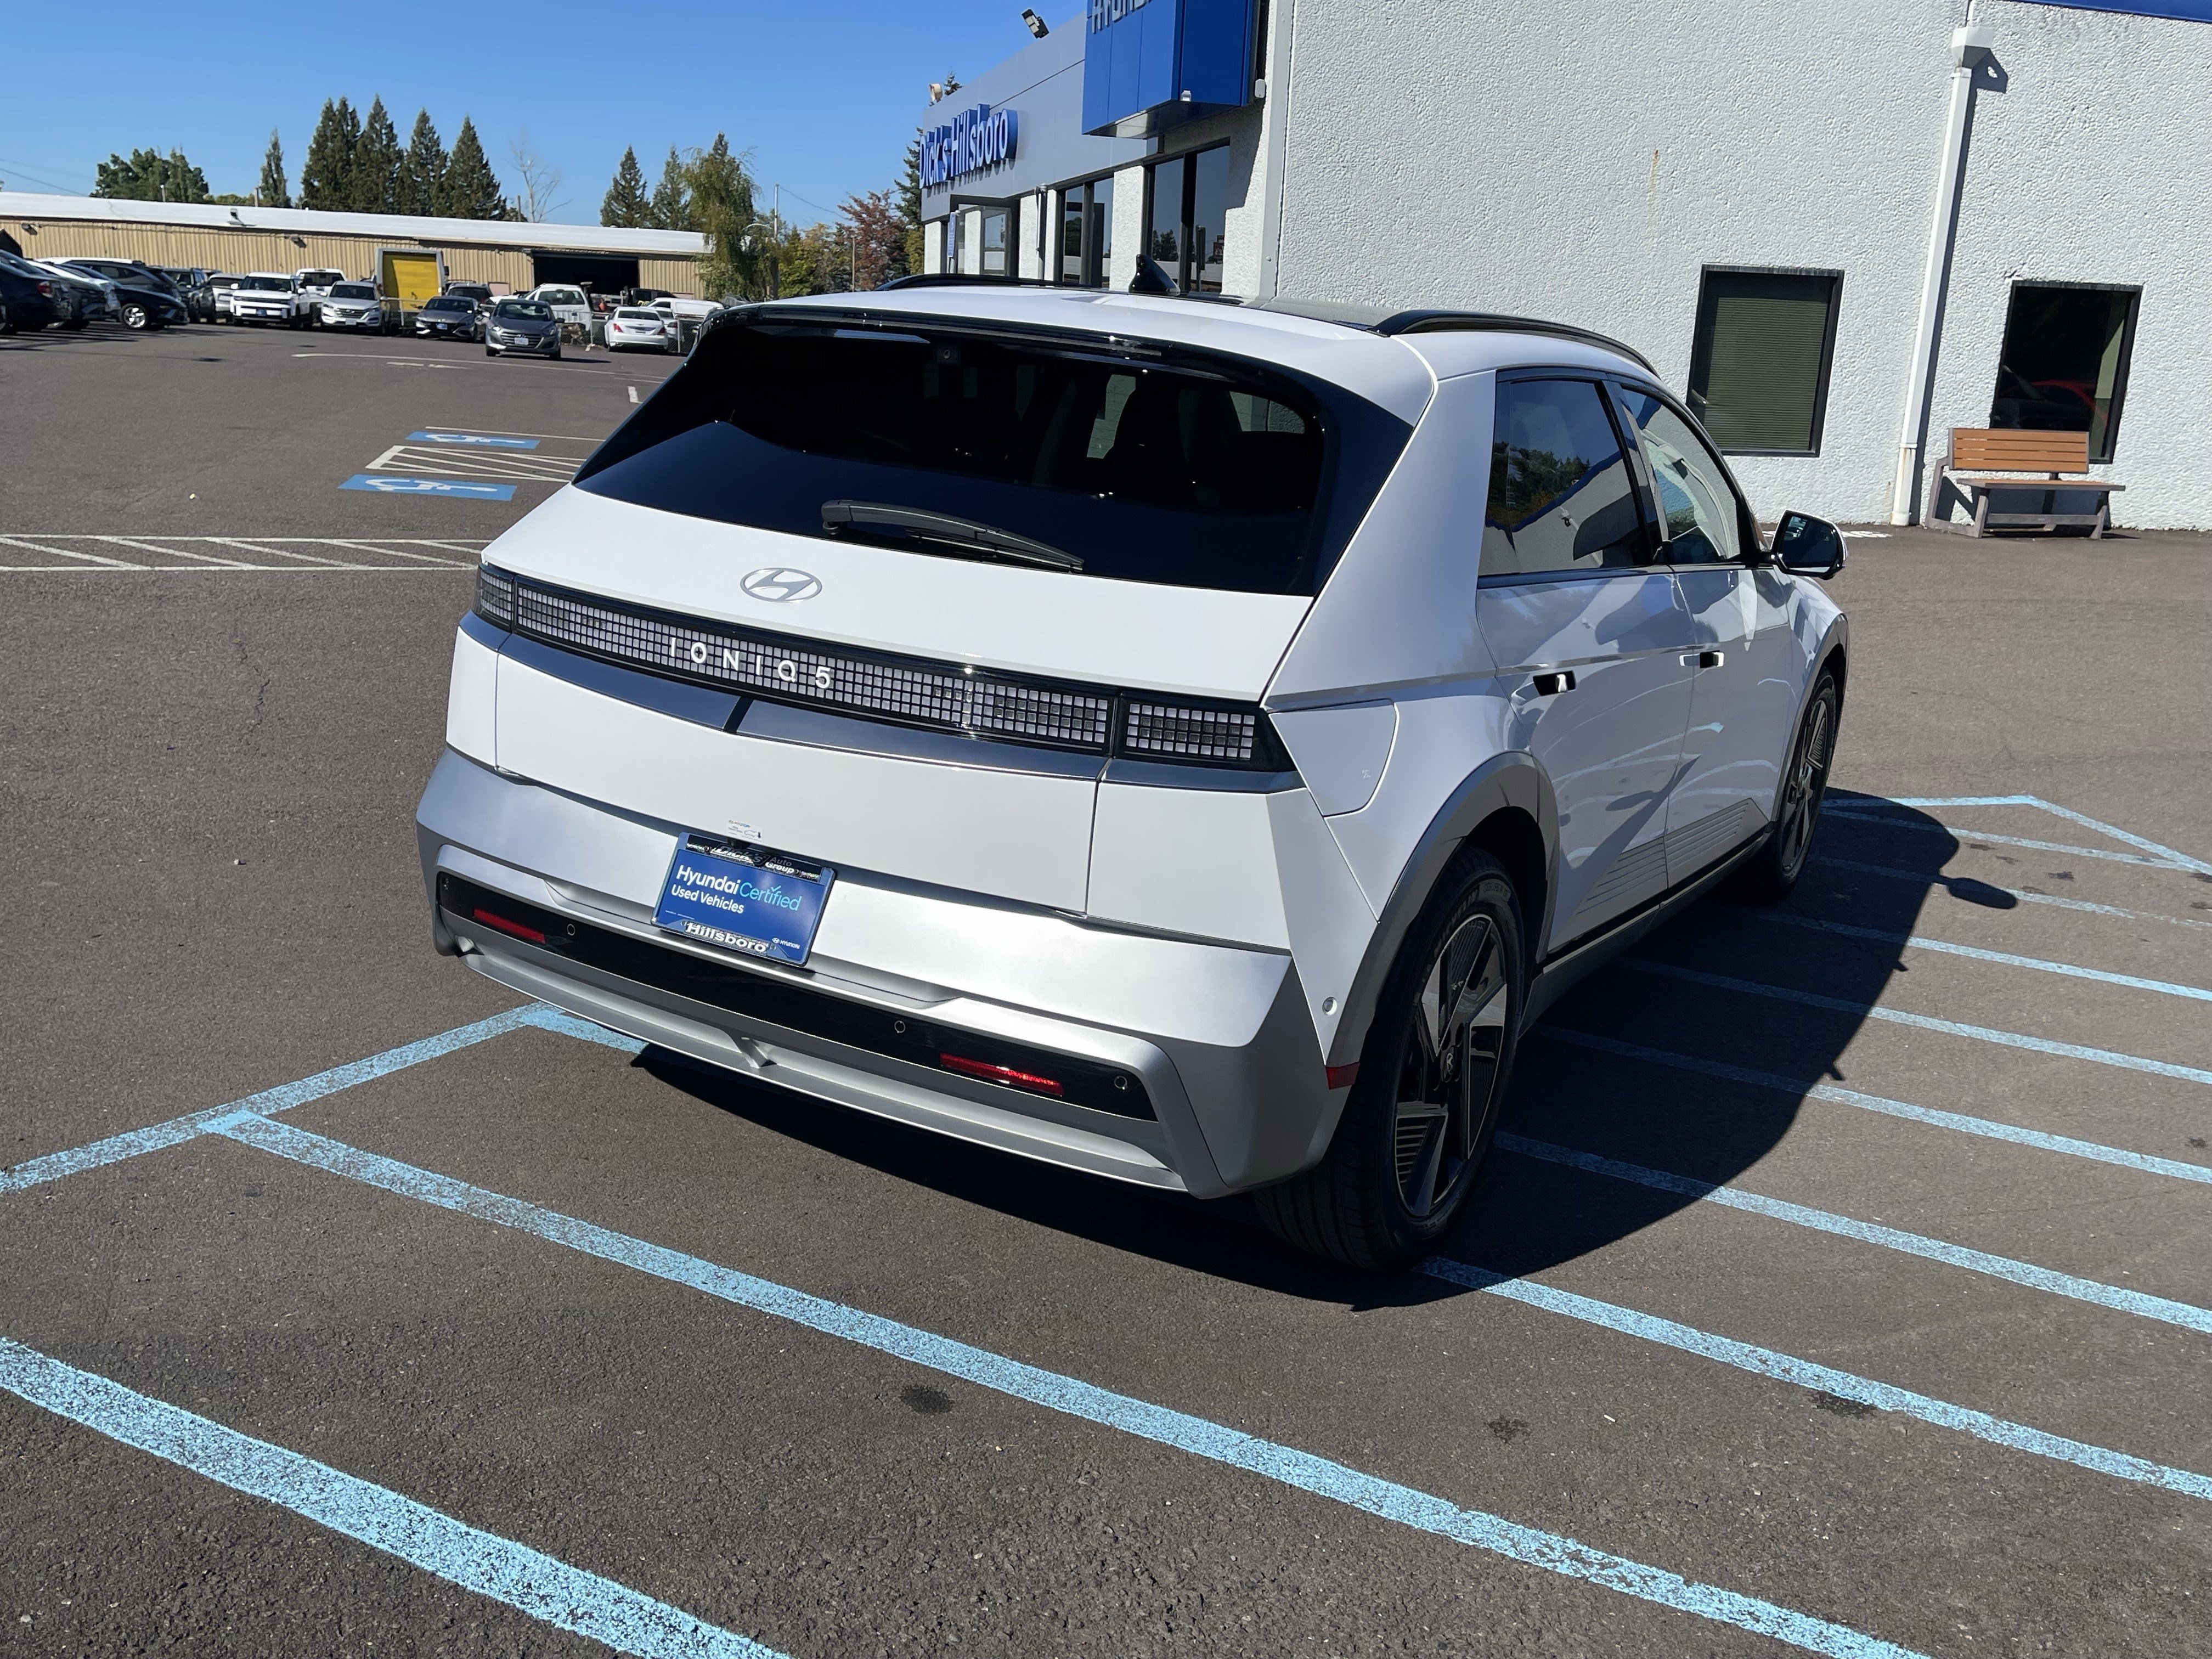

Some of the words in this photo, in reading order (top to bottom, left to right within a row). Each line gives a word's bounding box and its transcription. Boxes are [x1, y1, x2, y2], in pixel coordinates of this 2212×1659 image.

[919, 125, 951, 189] Dick's
[951, 103, 1018, 177] Hillsboro
[670, 637, 795, 682] IONIQ
[815, 667, 831, 689] 5
[765, 861, 795, 874] Group
[770, 856, 792, 867] Auto
[671, 884, 700, 902] Used
[700, 891, 744, 914] Vehicles
[685, 922, 767, 953] Hillsboro
[780, 940, 800, 949] HYUNDAI
